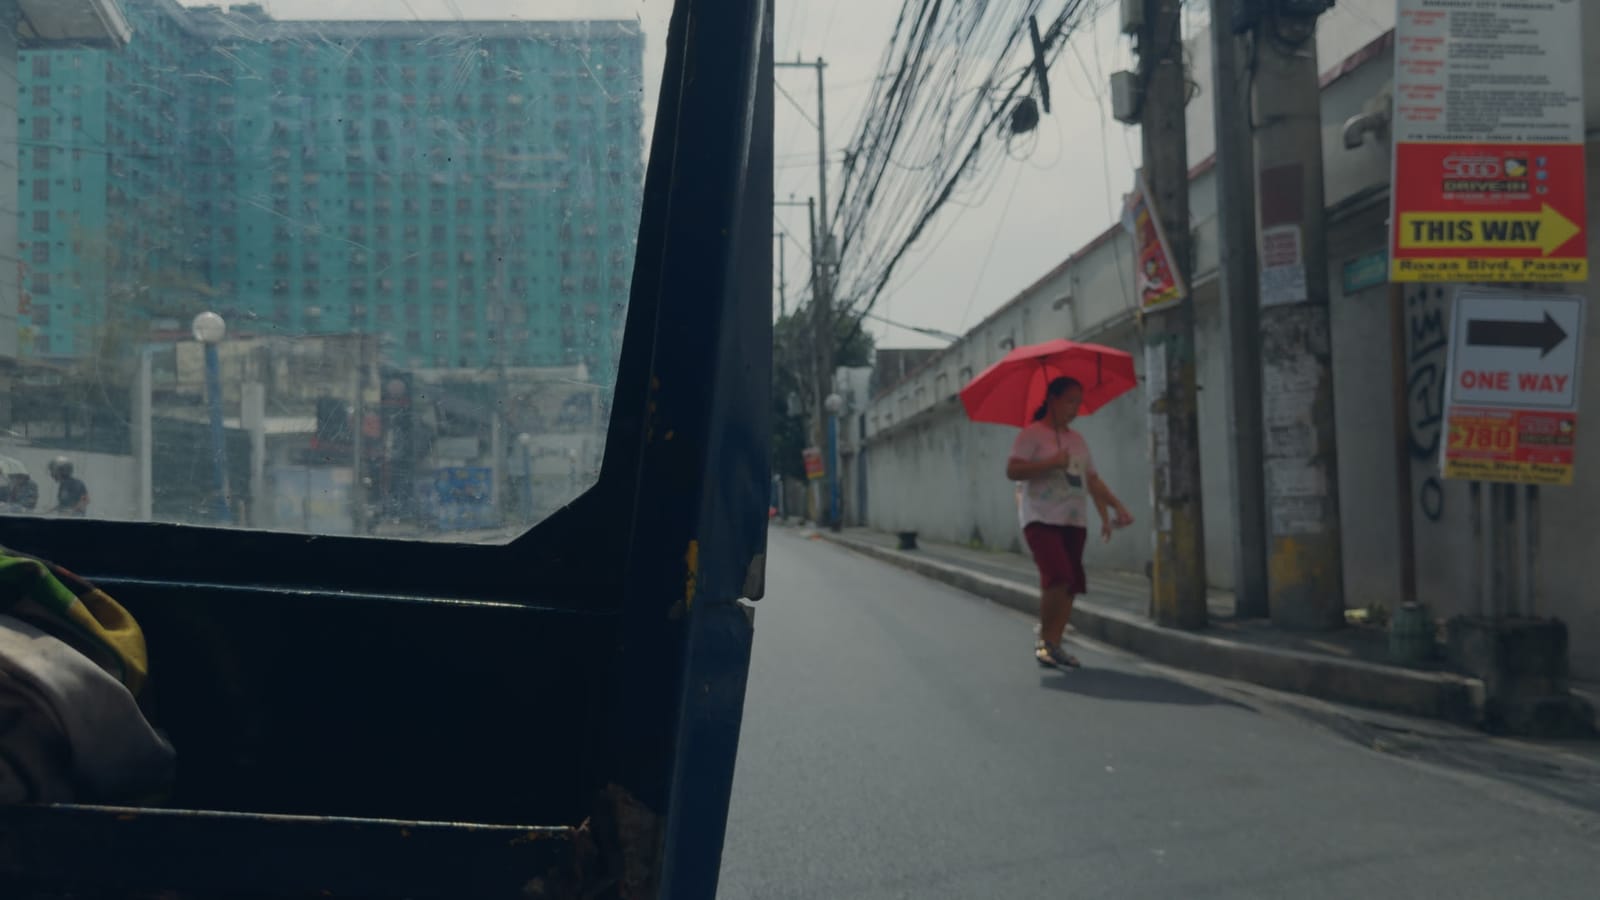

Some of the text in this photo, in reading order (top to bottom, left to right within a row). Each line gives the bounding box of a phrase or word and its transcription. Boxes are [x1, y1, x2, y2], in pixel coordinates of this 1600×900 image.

[1411, 220, 1541, 242] THIS WAY
[1400, 260, 1460, 271] Roxas
[1523, 260, 1582, 273] Pasay
[1460, 370, 1568, 393] ONE WAY
